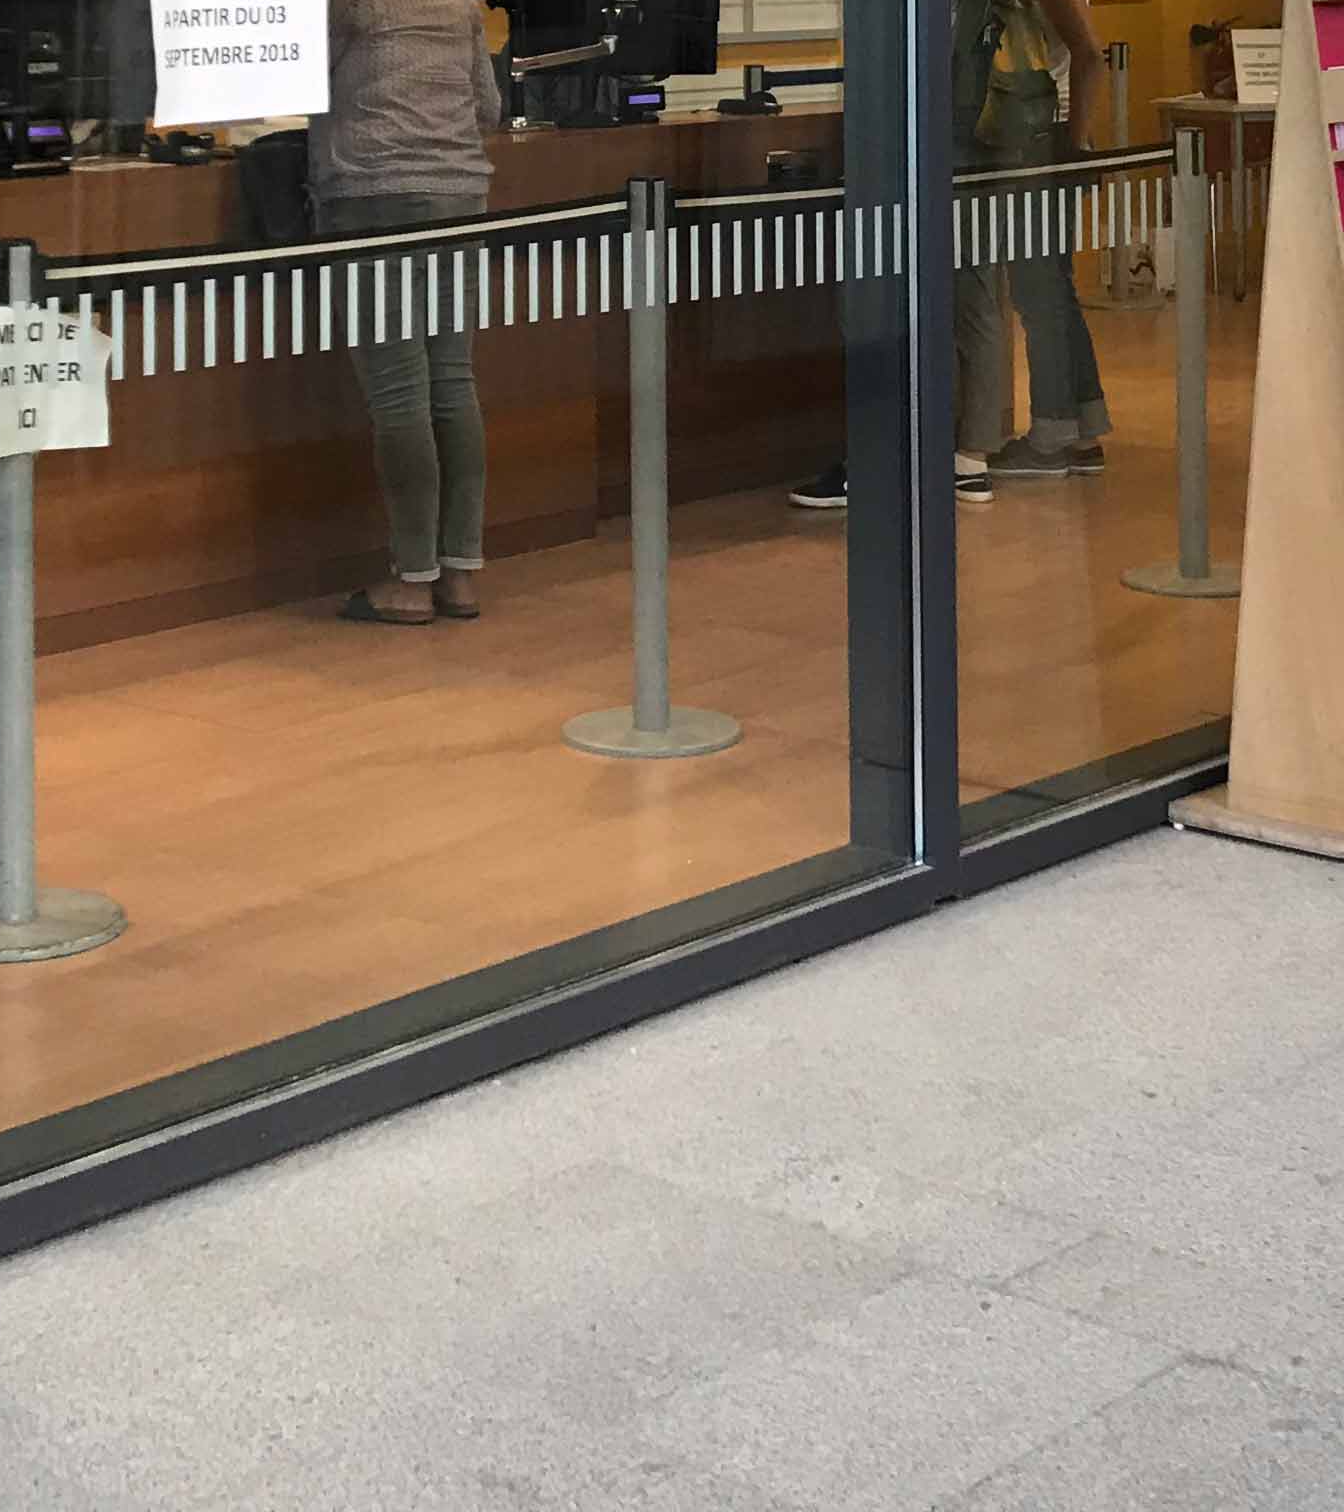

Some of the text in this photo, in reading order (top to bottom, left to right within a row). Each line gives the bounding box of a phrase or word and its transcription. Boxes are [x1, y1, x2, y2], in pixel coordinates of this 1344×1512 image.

[235, 7, 261, 25] DU
[266, 5, 287, 24] 03
[164, 42, 300, 69] SEPTEMBRE 2018
[18, 407, 37, 430] ICI
